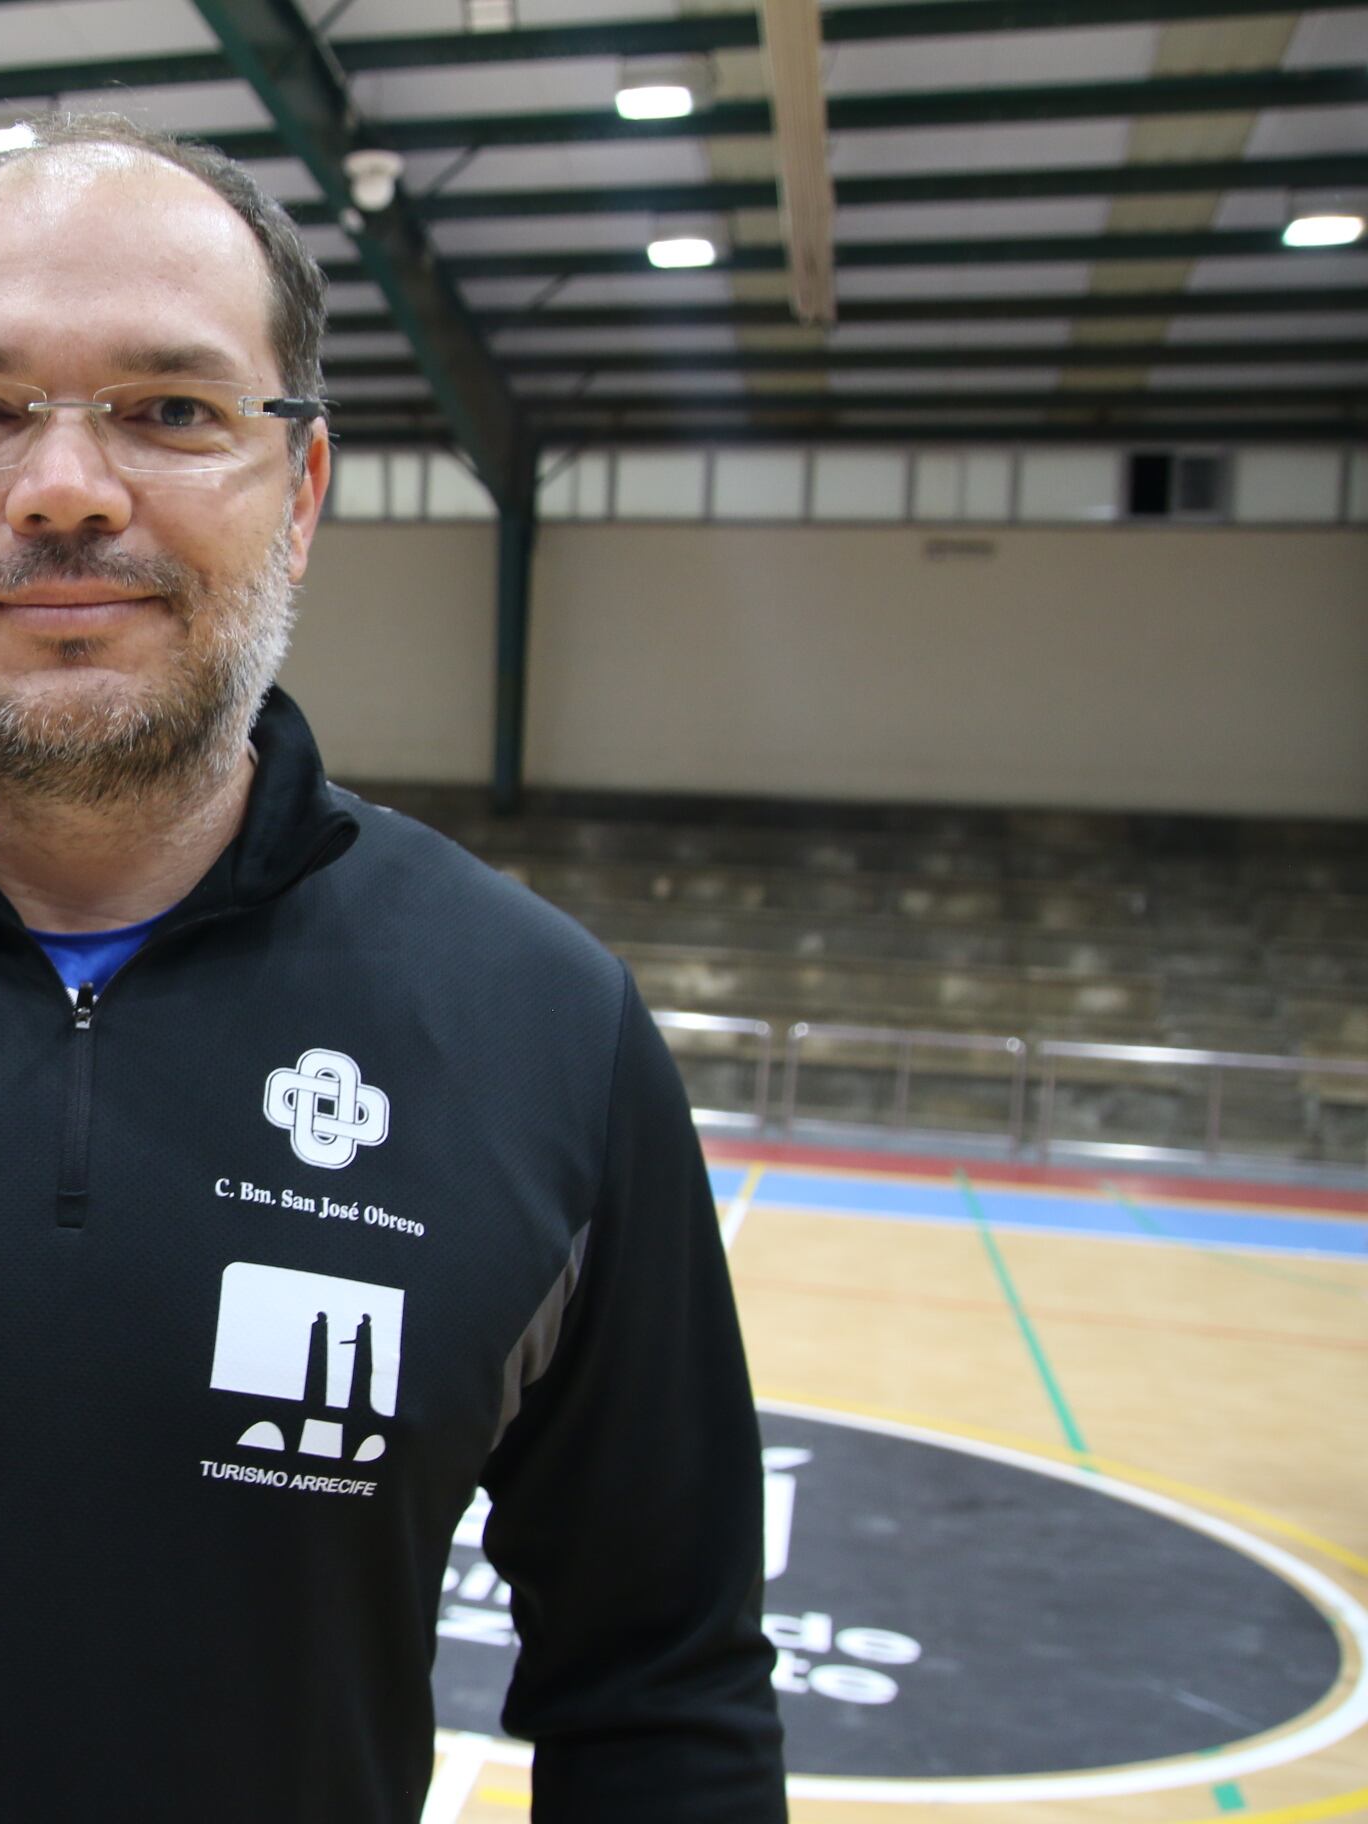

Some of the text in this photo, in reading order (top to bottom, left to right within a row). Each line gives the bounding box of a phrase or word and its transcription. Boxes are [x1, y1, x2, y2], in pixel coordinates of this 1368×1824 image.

[214, 1177, 425, 1237] C. Bm. San José Obrero
[199, 1460, 378, 1496] TURISMO ARRECIFE
